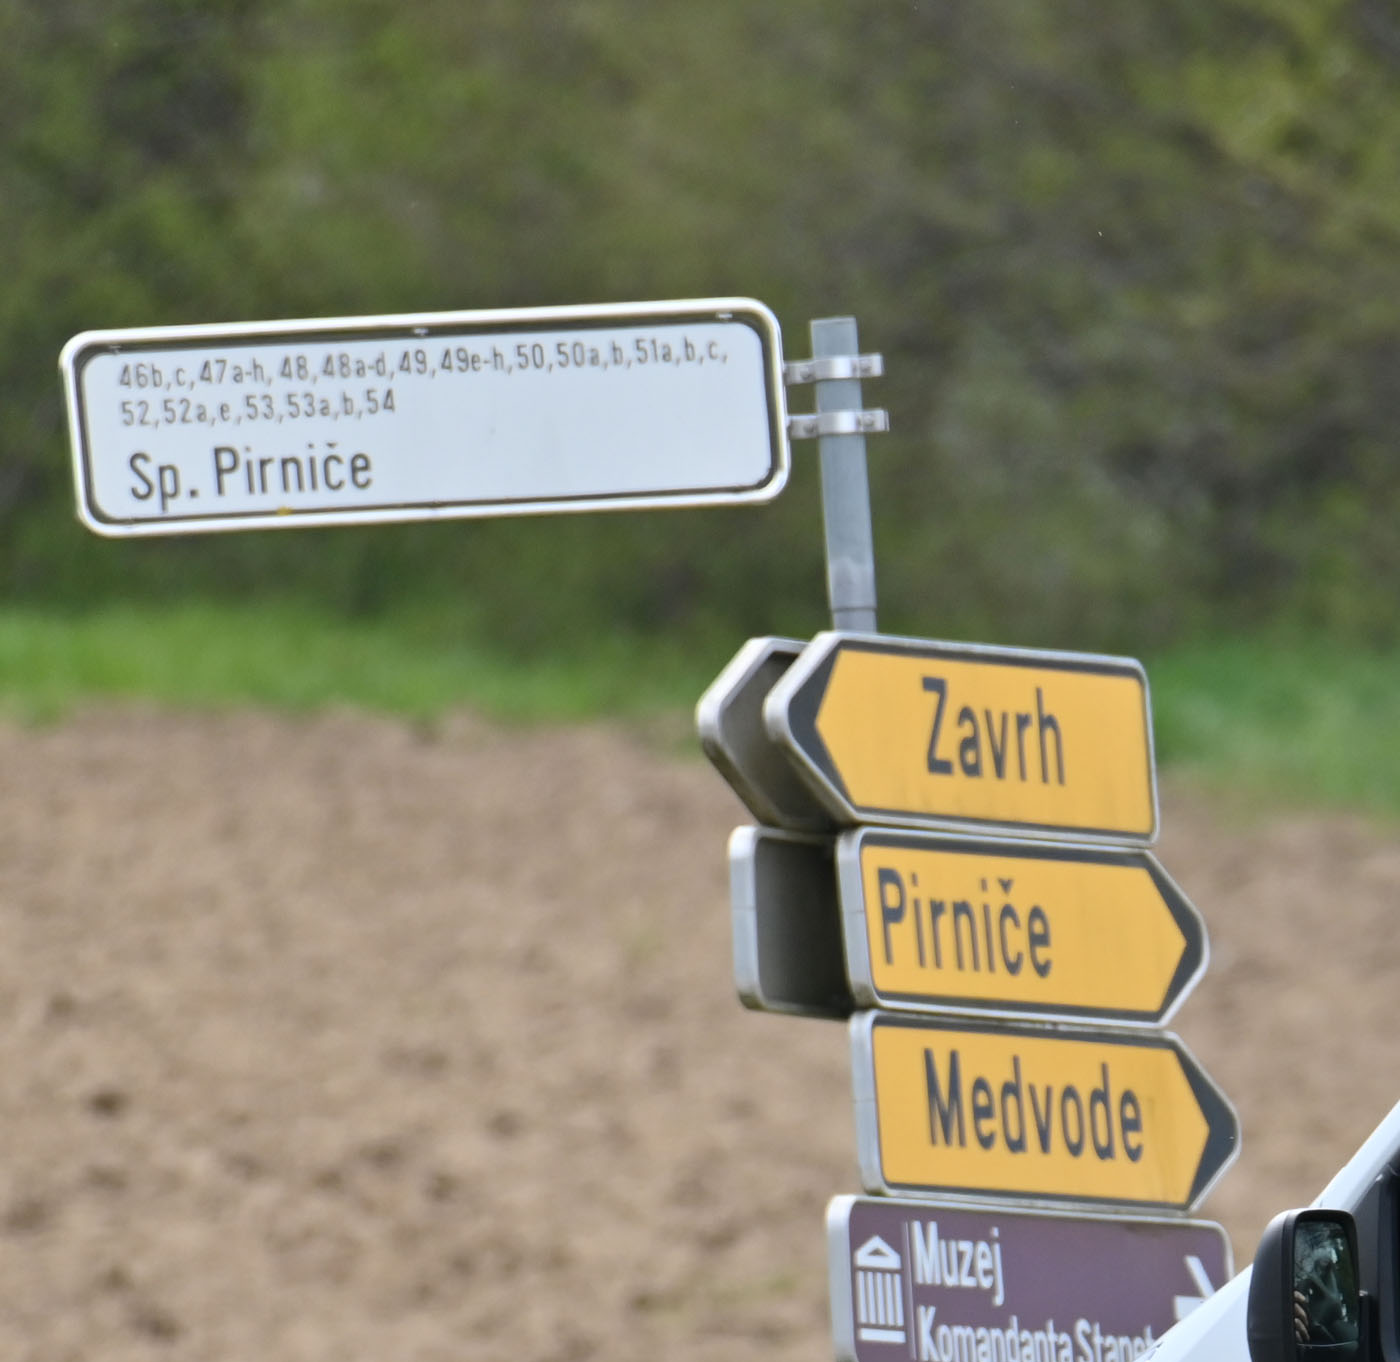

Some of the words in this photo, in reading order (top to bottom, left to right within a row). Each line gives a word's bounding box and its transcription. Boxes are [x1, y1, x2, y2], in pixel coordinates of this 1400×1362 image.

[129, 452, 199, 514] Sp.
[213, 442, 372, 497] Pirniče
[921, 675, 1066, 787] Zavrh
[877, 866, 1053, 979] Pirniče
[923, 1046, 1144, 1164] Medvode
[911, 1219, 1005, 1307] Muzej
